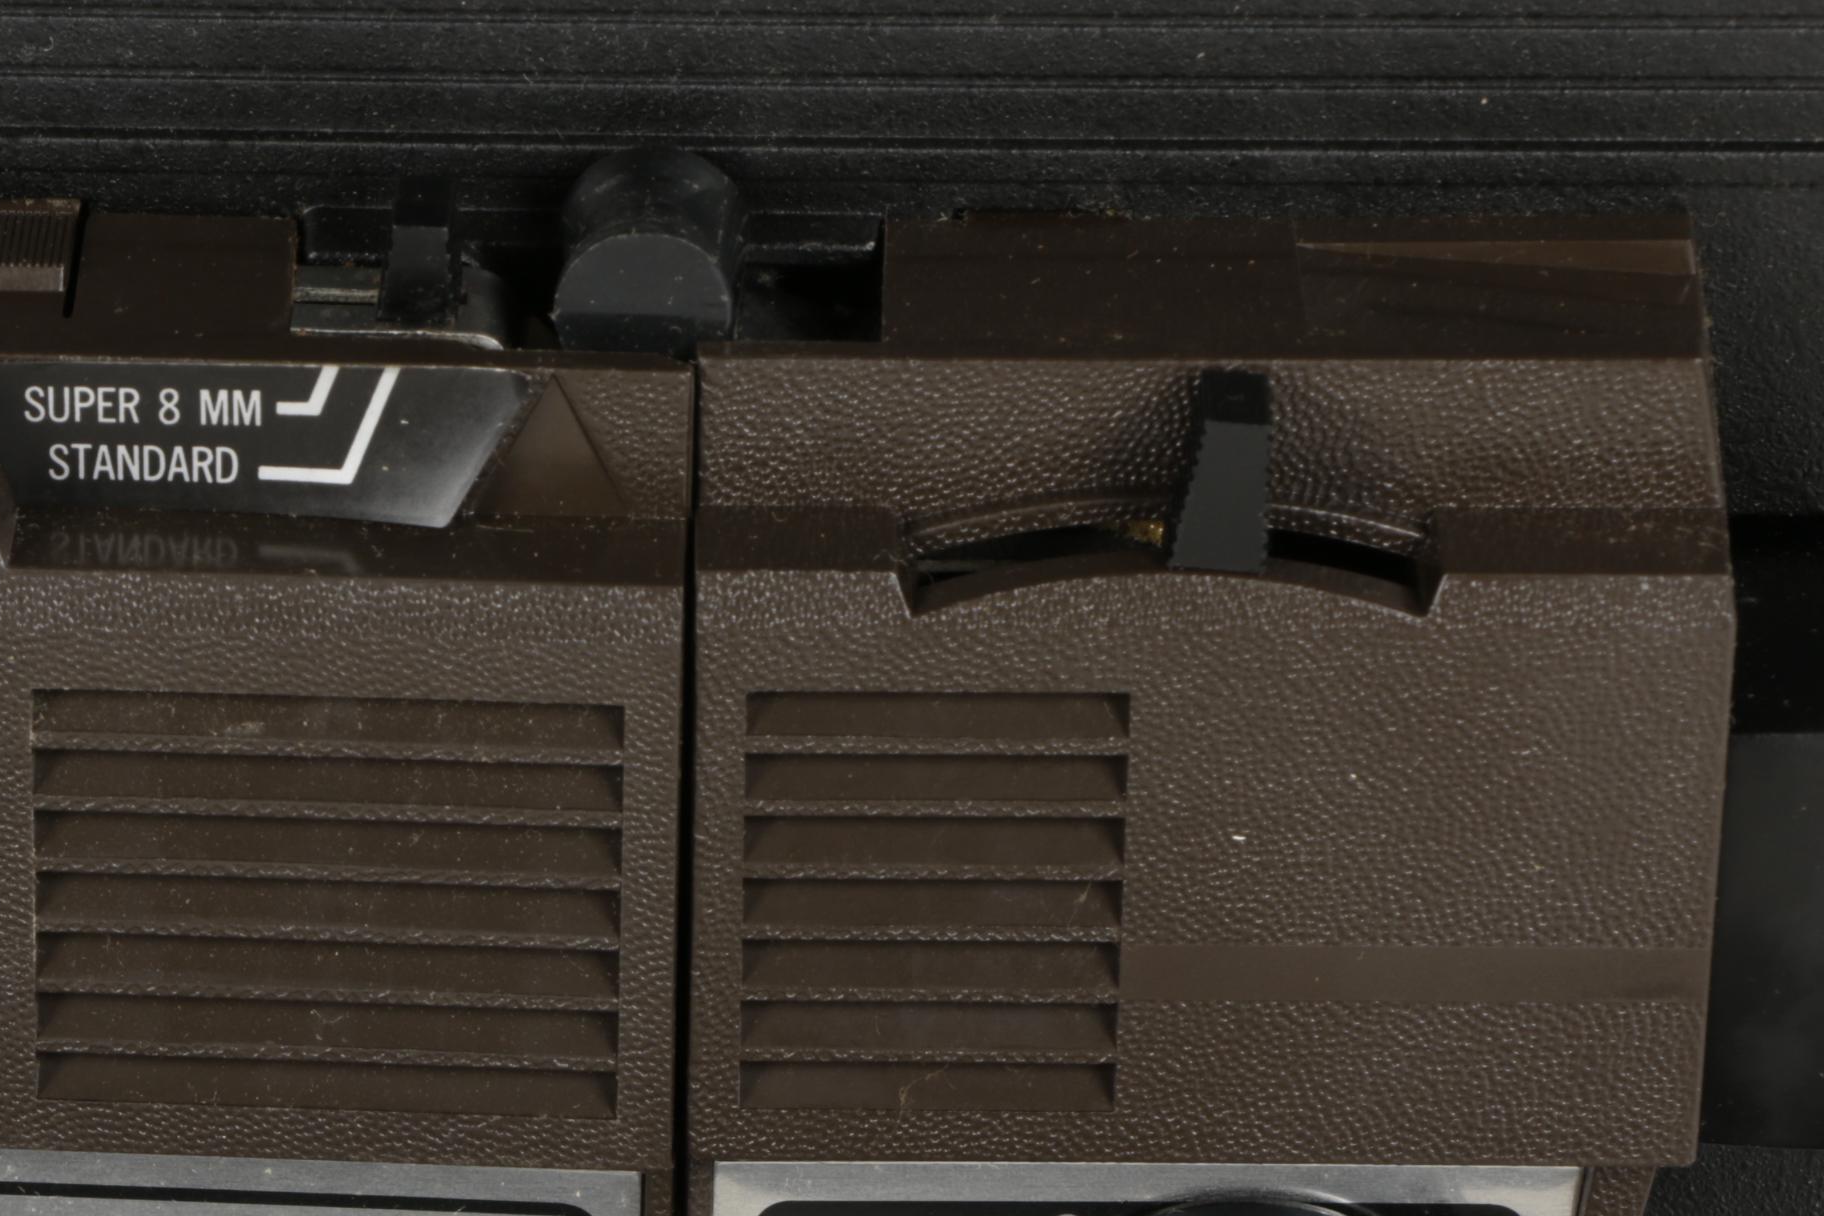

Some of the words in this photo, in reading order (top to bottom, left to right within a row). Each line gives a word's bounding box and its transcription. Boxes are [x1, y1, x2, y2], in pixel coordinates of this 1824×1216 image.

[24, 385, 141, 424] SUPER
[158, 387, 181, 426] 8
[199, 388, 262, 427] MM
[49, 443, 239, 484] STANDARD
